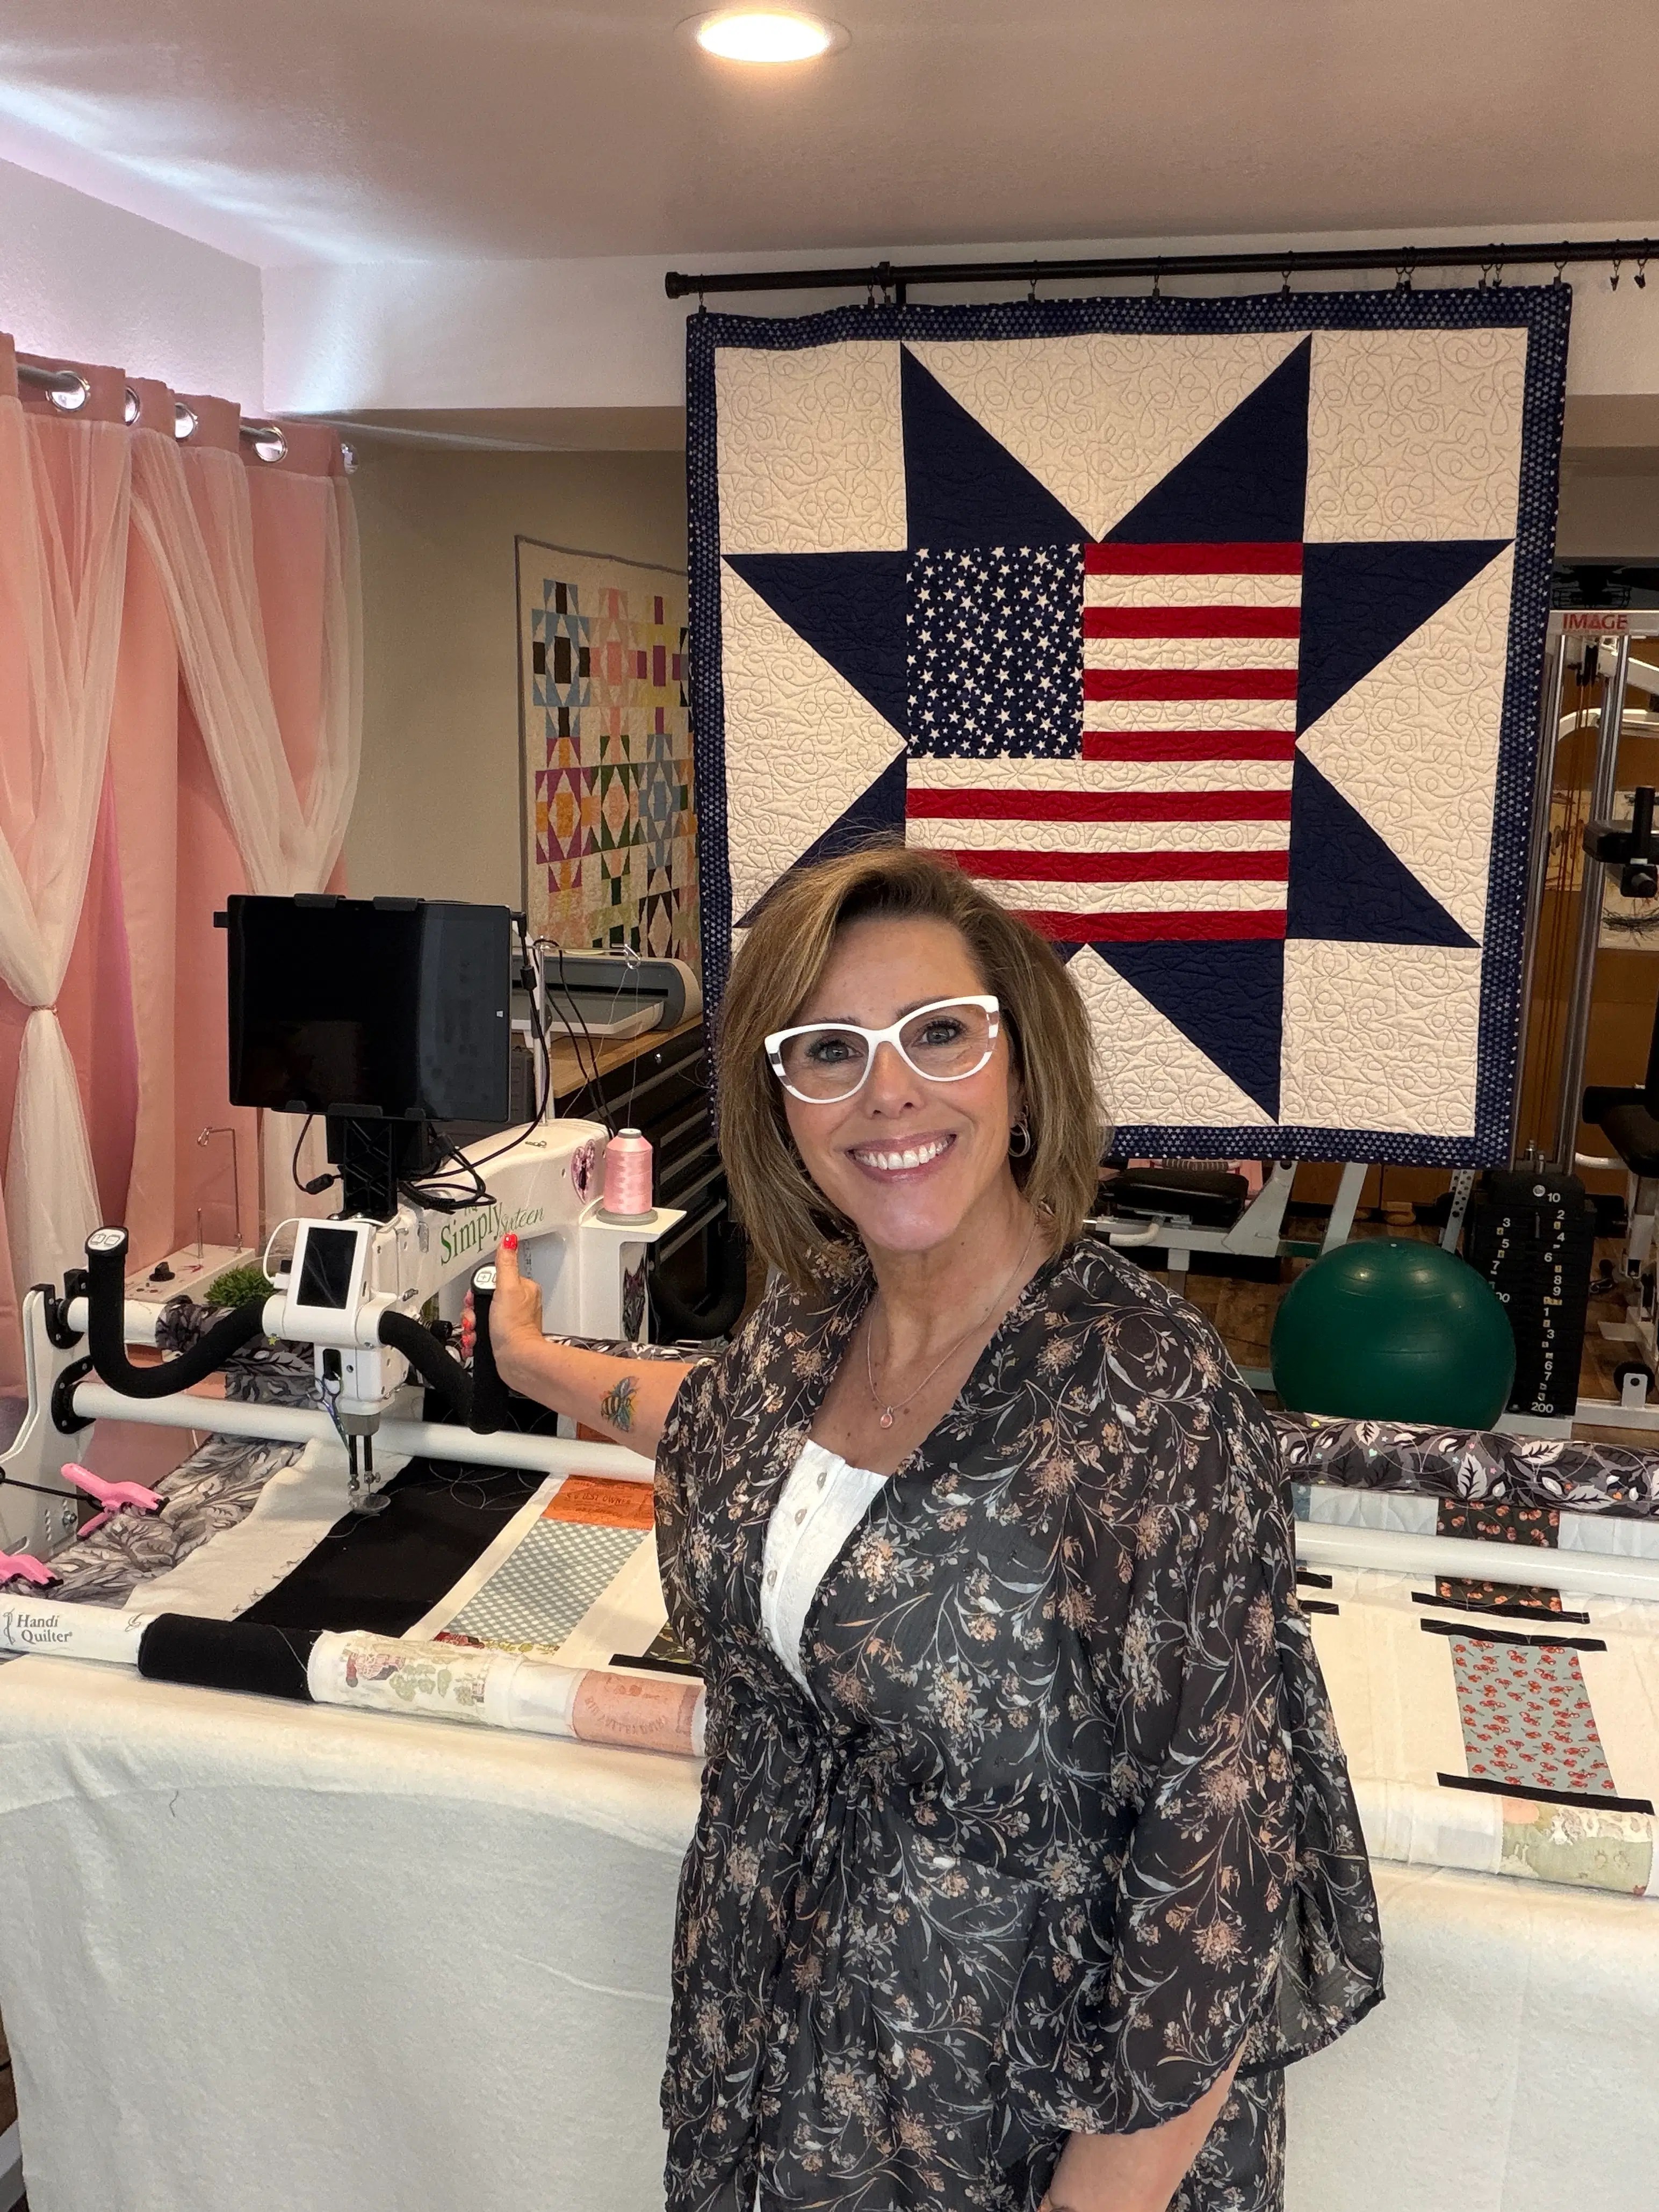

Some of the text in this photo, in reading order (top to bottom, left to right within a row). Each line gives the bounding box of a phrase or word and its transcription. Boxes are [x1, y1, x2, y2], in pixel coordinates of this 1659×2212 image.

[1563, 613, 1628, 629] IMAGE
[1547, 1192, 1561, 1202] 10
[1557, 1210, 1565, 1220] 2
[1503, 1217, 1511, 1227] 3
[441, 1201, 502, 1266] Simply
[1557, 1232, 1565, 1242] 4
[1502, 1238, 1510, 1248] 5
[1544, 1252, 1553, 1262] 6
[1492, 1260, 1500, 1270] 7
[1554, 1275, 1562, 1285] 8
[1553, 1286, 1561, 1296] 9
[1543, 1307, 1549, 1316] 1
[1547, 1329, 1555, 1338] 3
[1545, 1361, 1553, 1371] 6
[1544, 1372, 1552, 1381] 7
[1531, 1402, 1554, 1413] 200
[17, 1614, 60, 1627] Handi
